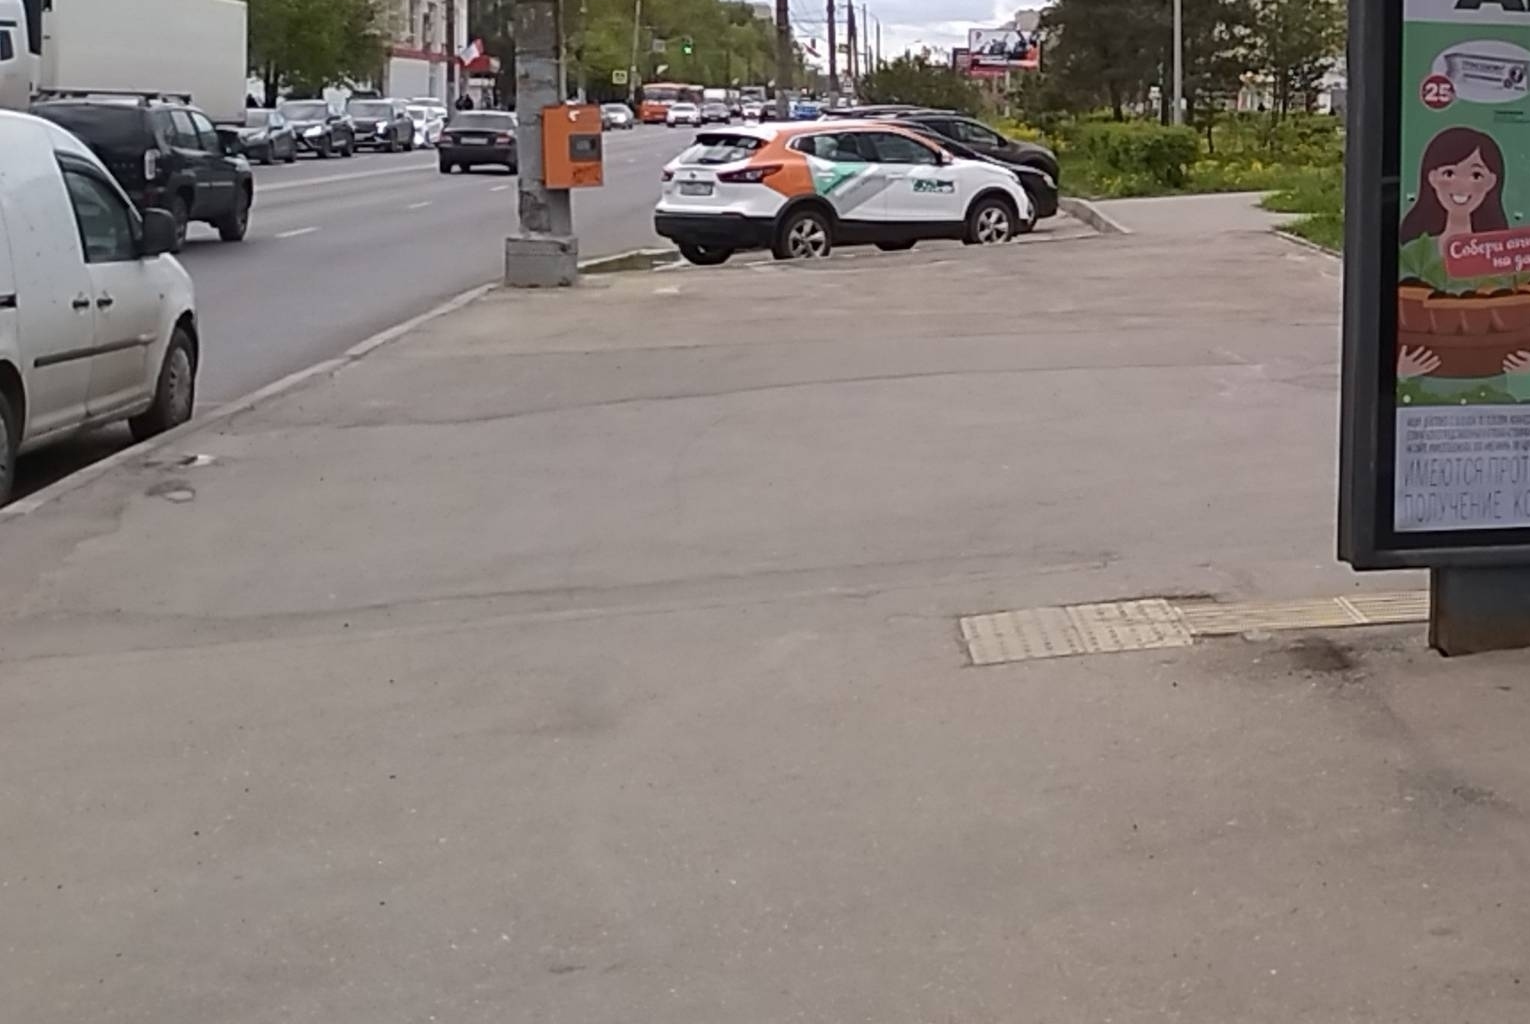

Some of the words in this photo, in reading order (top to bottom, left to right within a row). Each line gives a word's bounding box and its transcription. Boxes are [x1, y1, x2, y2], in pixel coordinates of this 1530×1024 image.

[1424, 83, 1451, 102] 25
[1450, 239, 1503, 259] Собери
[1493, 257, 1511, 267] на
[1404, 456, 1482, 487] ИМЕЮТСЯ
[1404, 490, 1502, 523] ПОЛУЧЕНИЕ
